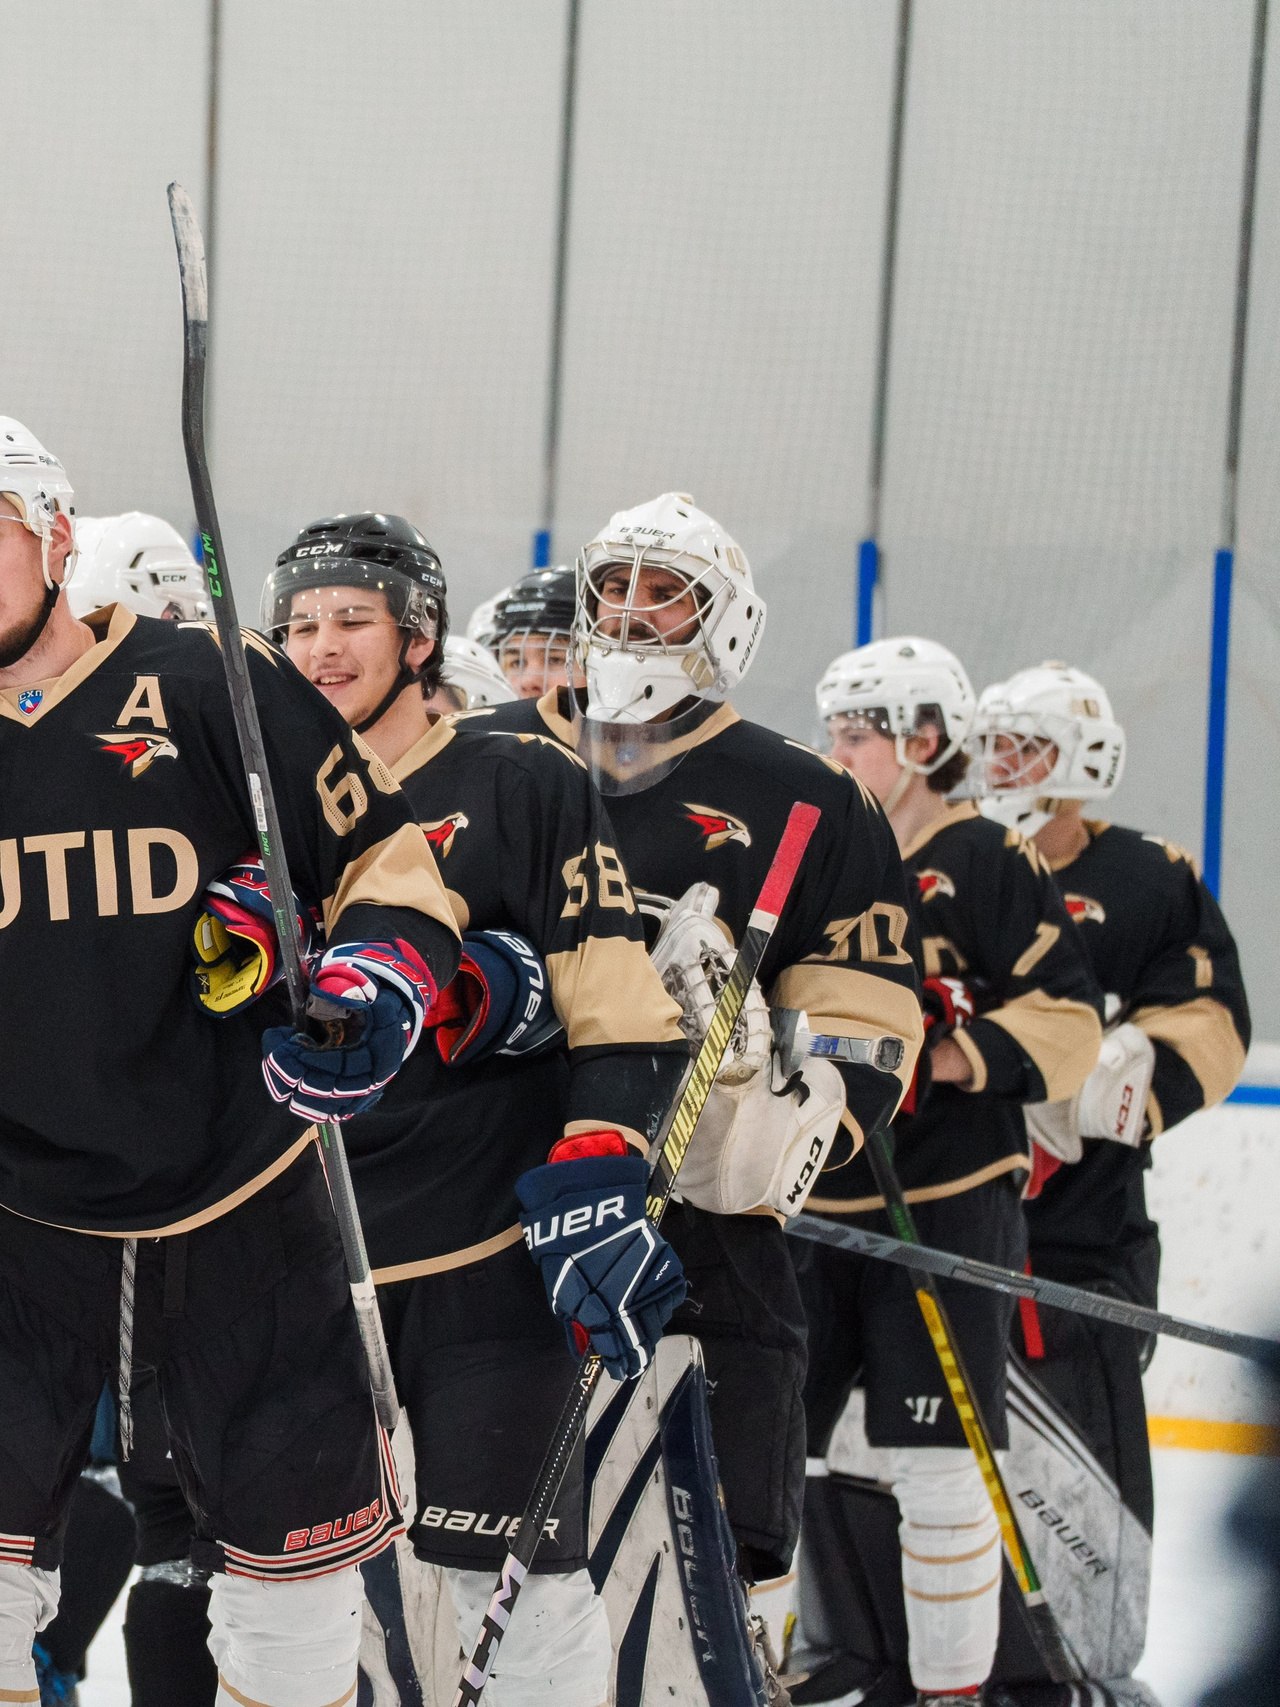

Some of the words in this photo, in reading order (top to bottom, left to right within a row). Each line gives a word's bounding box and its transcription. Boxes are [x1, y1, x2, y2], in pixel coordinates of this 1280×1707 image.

[295, 542, 344, 558] CCM
[619, 526, 676, 540] BAUER
[161, 574, 187, 583] CCM
[200, 531, 223, 599] CCM
[420, 572, 443, 587] CCM
[738, 608, 764, 674] BAUER
[115, 675, 169, 730] A
[561, 840, 636, 915] 58
[484, 929, 546, 1046] BAUE
[786, 1135, 825, 1205] CCM
[282, 1497, 381, 1552] BAUER
[1017, 1488, 1109, 1577] BAUER
